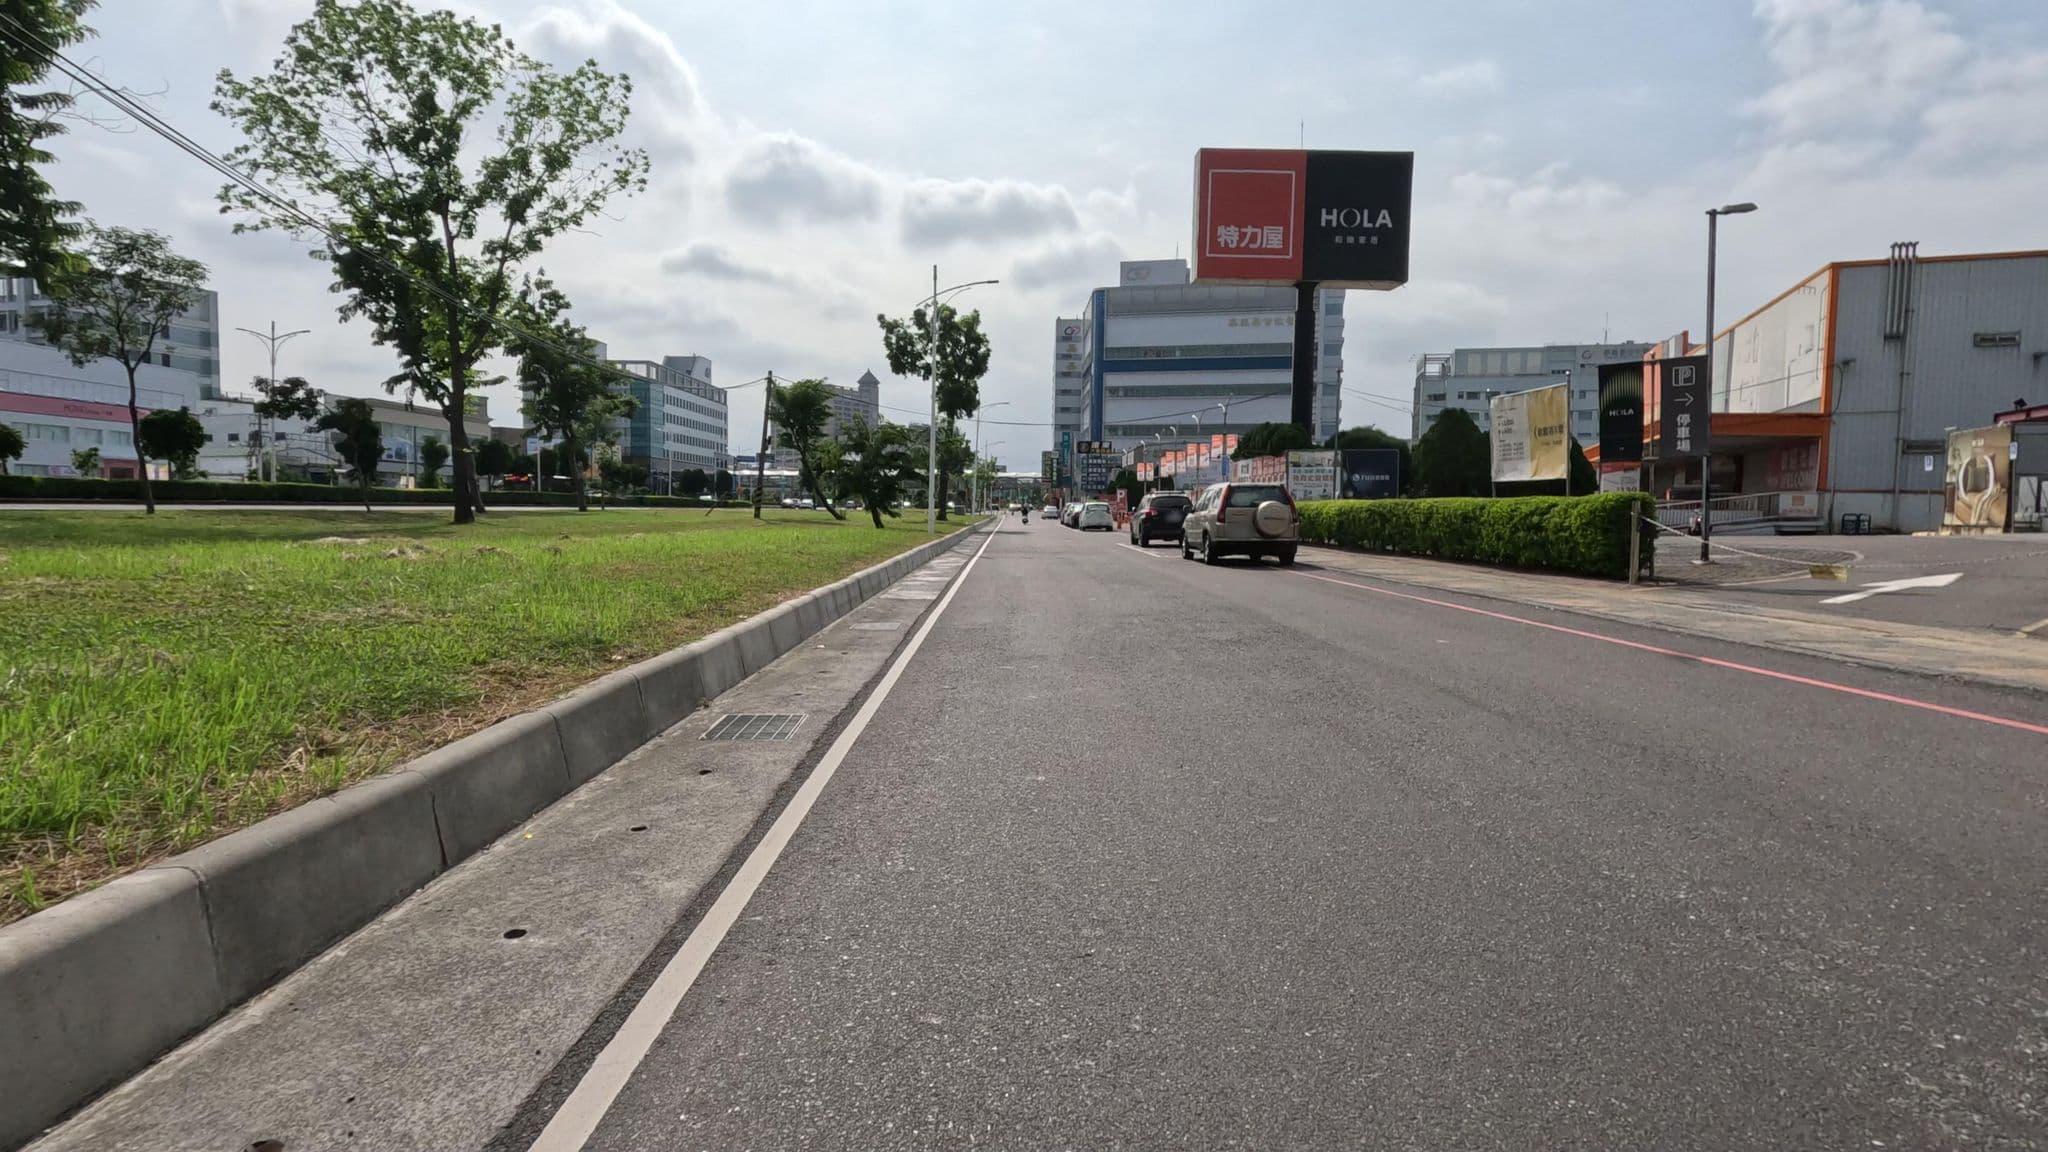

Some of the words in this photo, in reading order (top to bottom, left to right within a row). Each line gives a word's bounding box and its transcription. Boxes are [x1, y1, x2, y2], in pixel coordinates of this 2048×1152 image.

[1320, 207, 1393, 229] HOLA
[1216, 224, 1284, 249] 特力屋
[1608, 408, 1635, 418] HOLA
[1676, 413, 1692, 452] 停車場
